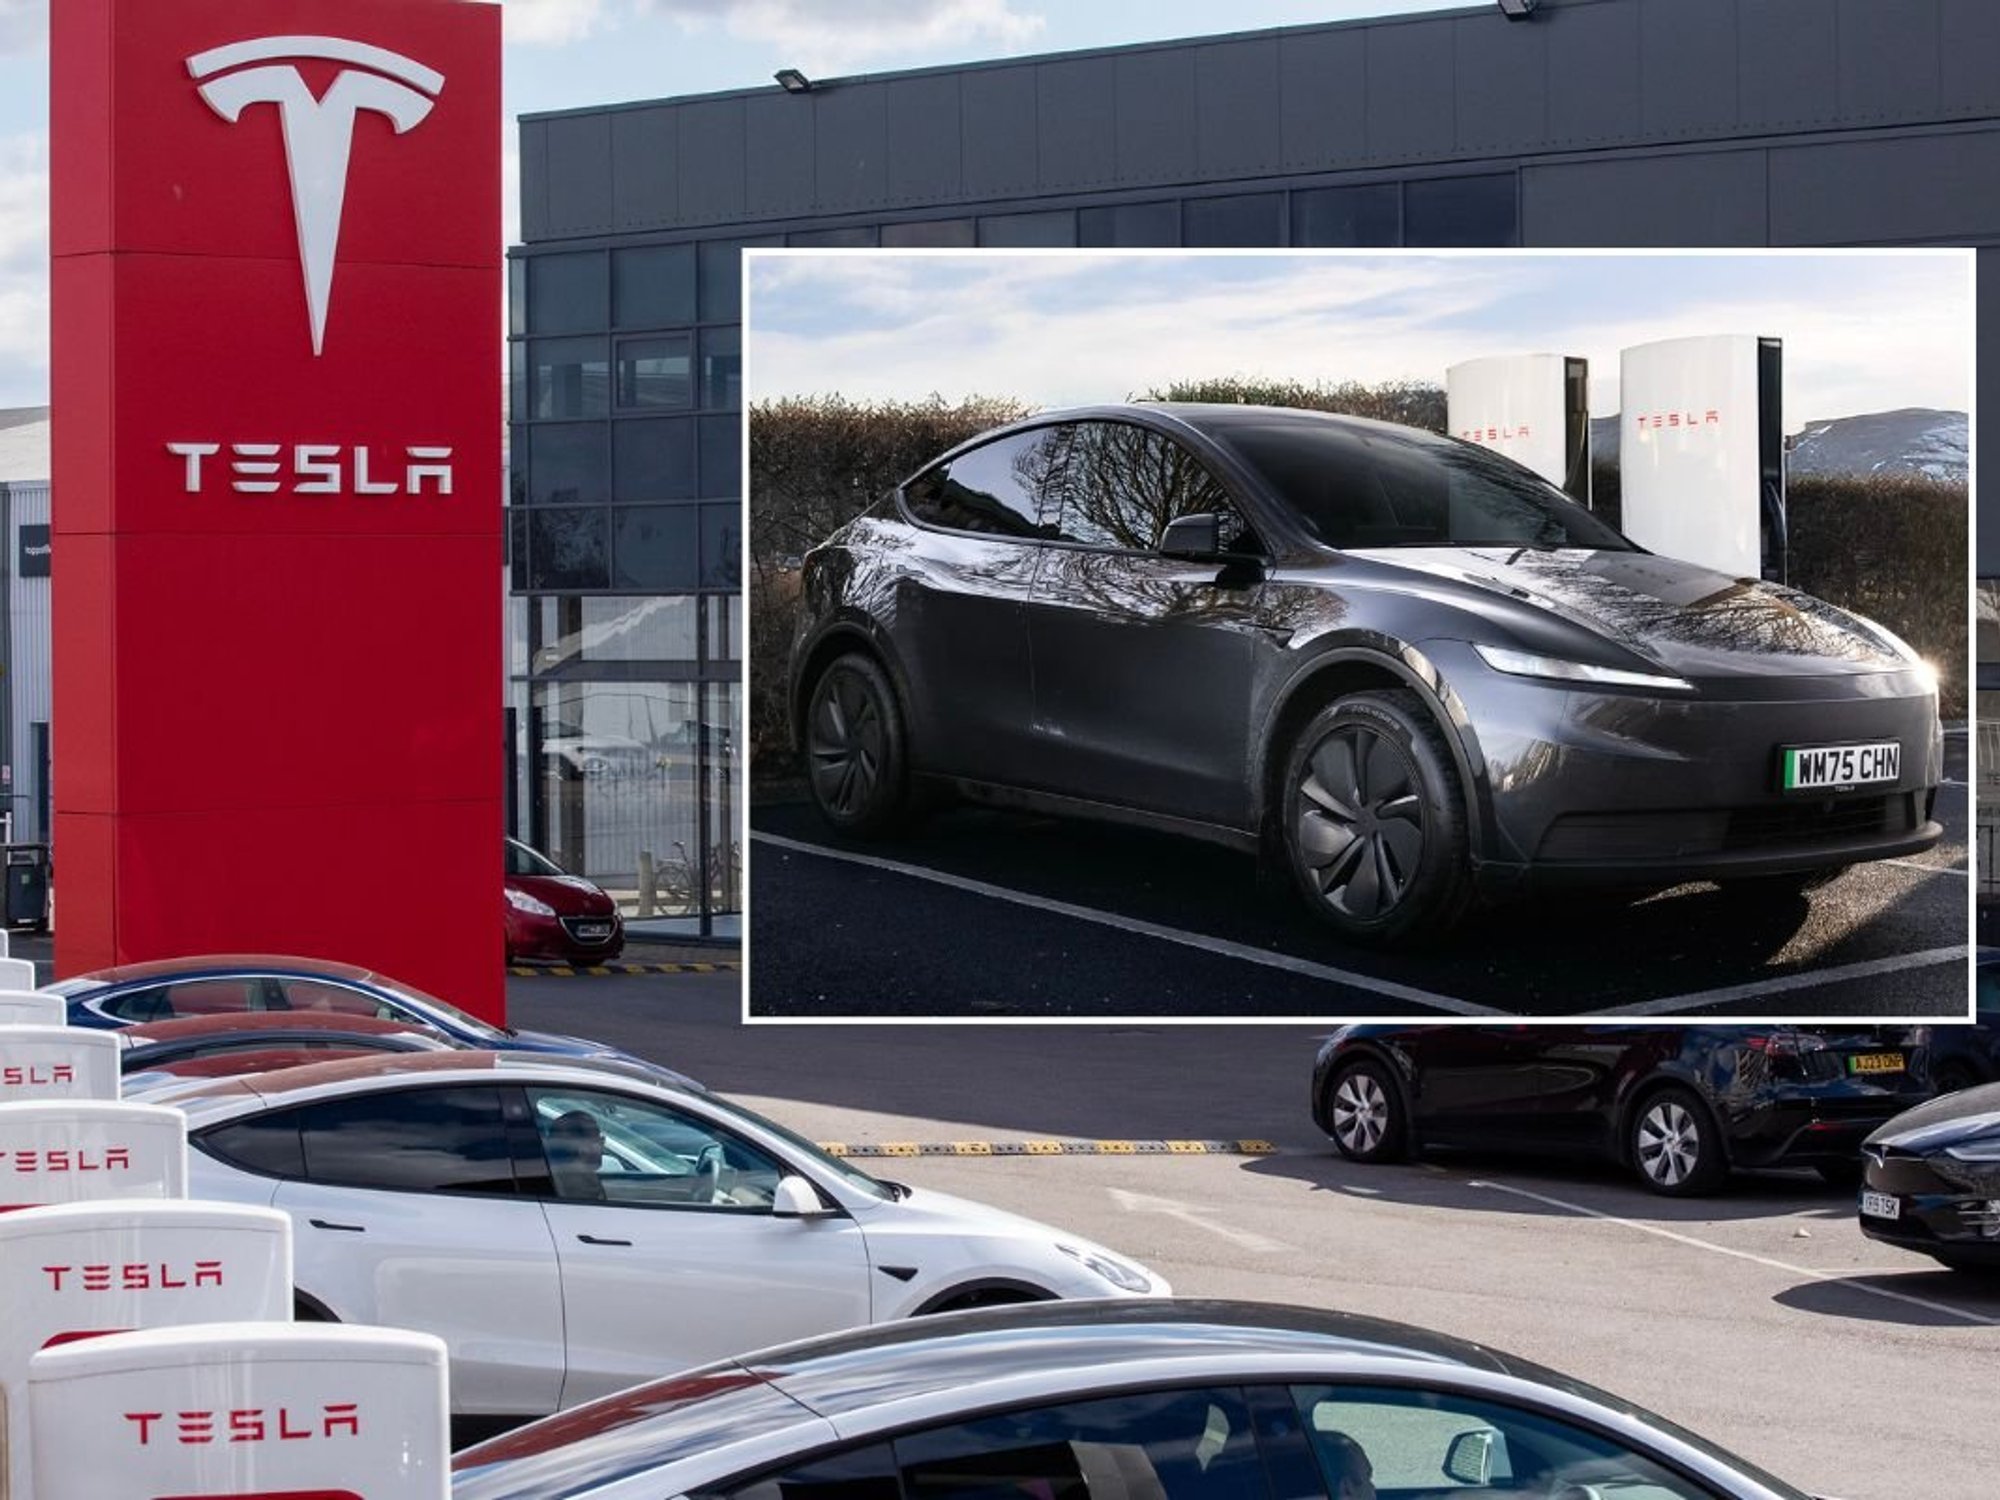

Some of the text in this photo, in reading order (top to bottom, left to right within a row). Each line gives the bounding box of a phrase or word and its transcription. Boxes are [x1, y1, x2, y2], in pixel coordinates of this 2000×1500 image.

[1637, 410, 1719, 429] TESLA
[1462, 426, 1529, 441] TESLA
[166, 443, 453, 494] TESLA
[1800, 747, 1898, 784] WM75 CHN
[4, 1065, 73, 1085] SLA
[0, 1149, 130, 1173] ESLA
[42, 1261, 223, 1291] TESLA
[123, 1403, 358, 1444] TESLA
